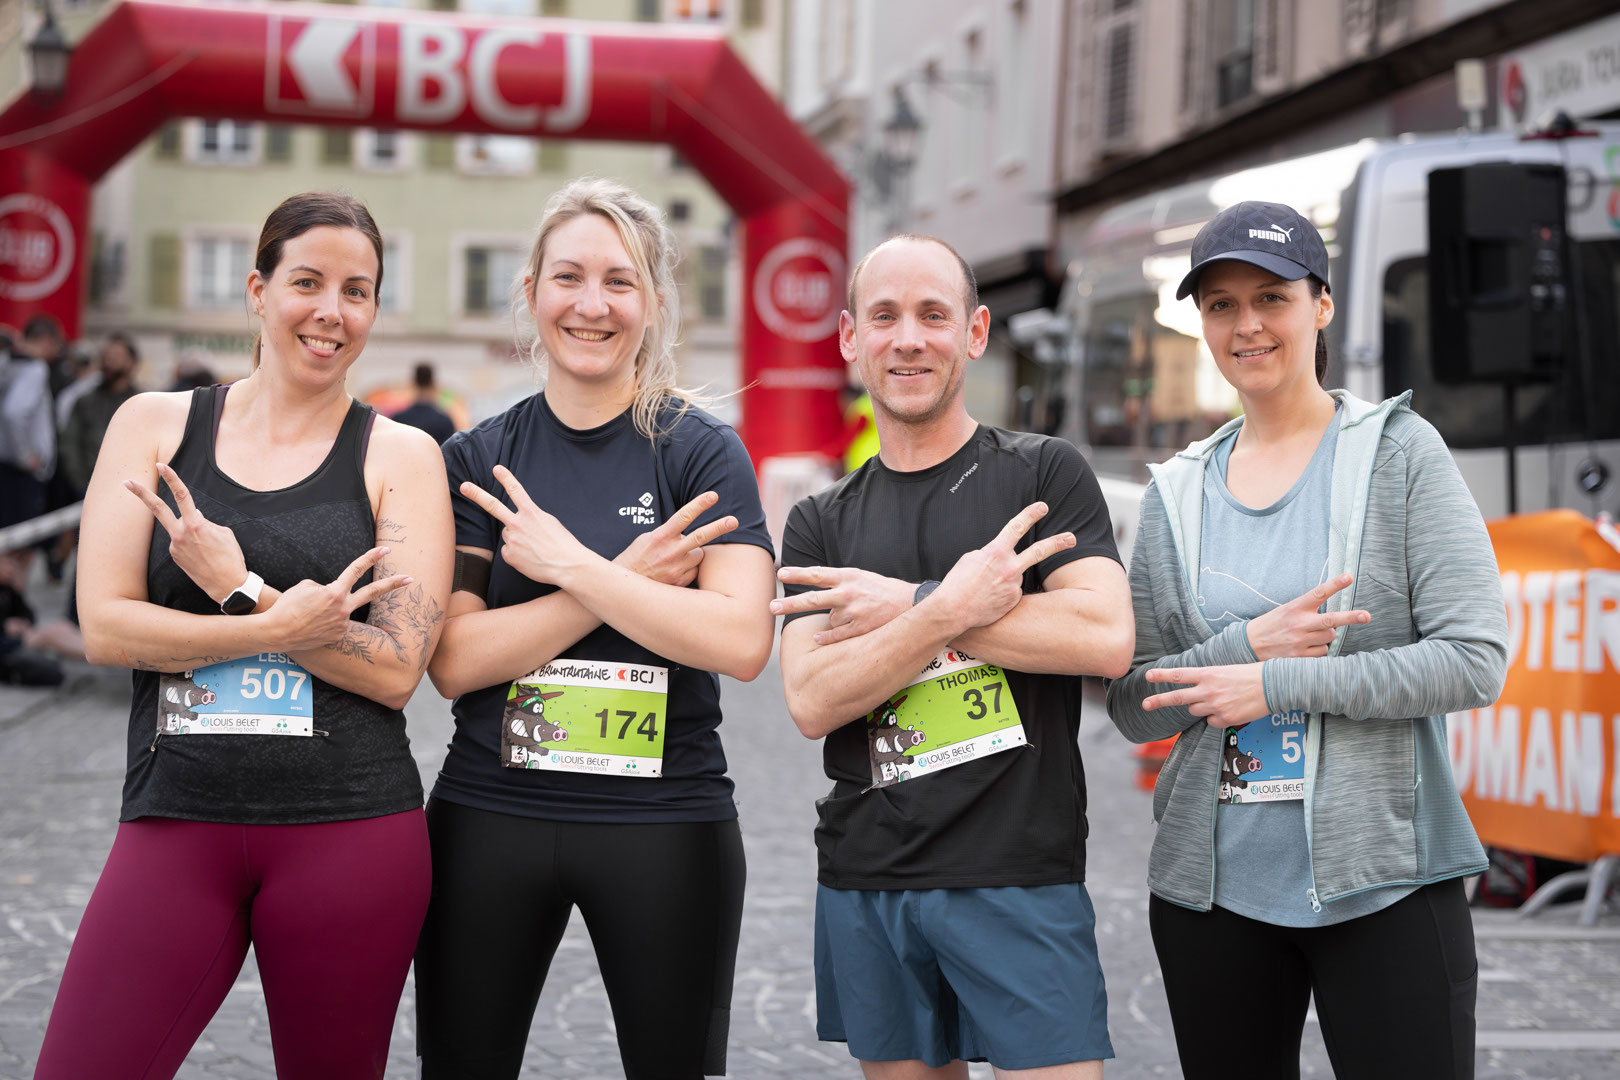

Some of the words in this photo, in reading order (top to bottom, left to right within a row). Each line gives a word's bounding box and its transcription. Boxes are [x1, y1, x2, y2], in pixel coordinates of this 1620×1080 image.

[1587, 42, 1620, 87] TO
[397, 23, 593, 132] BCJ
[1249, 229, 1286, 244] PUMA
[258, 653, 298, 666] LESL
[240, 667, 307, 701] 507
[630, 670, 655, 684] BCJ
[936, 665, 998, 691] THOMAS
[963, 681, 1003, 721] 37
[171, 713, 177, 723] 2
[209, 718, 234, 727] LOUIS
[235, 718, 260, 727] BELET
[595, 708, 659, 742] 174
[516, 746, 523, 755] 2
[927, 750, 951, 765] LOUIS
[951, 742, 976, 757] BELET
[1282, 731, 1307, 764] 5
[560, 755, 585, 765] LOUIS
[586, 757, 611, 767] BELET
[885, 762, 893, 772] 2
[1447, 706, 1620, 819] OMAN
[1222, 782, 1228, 791] 2
[1259, 784, 1281, 794] LOUIS
